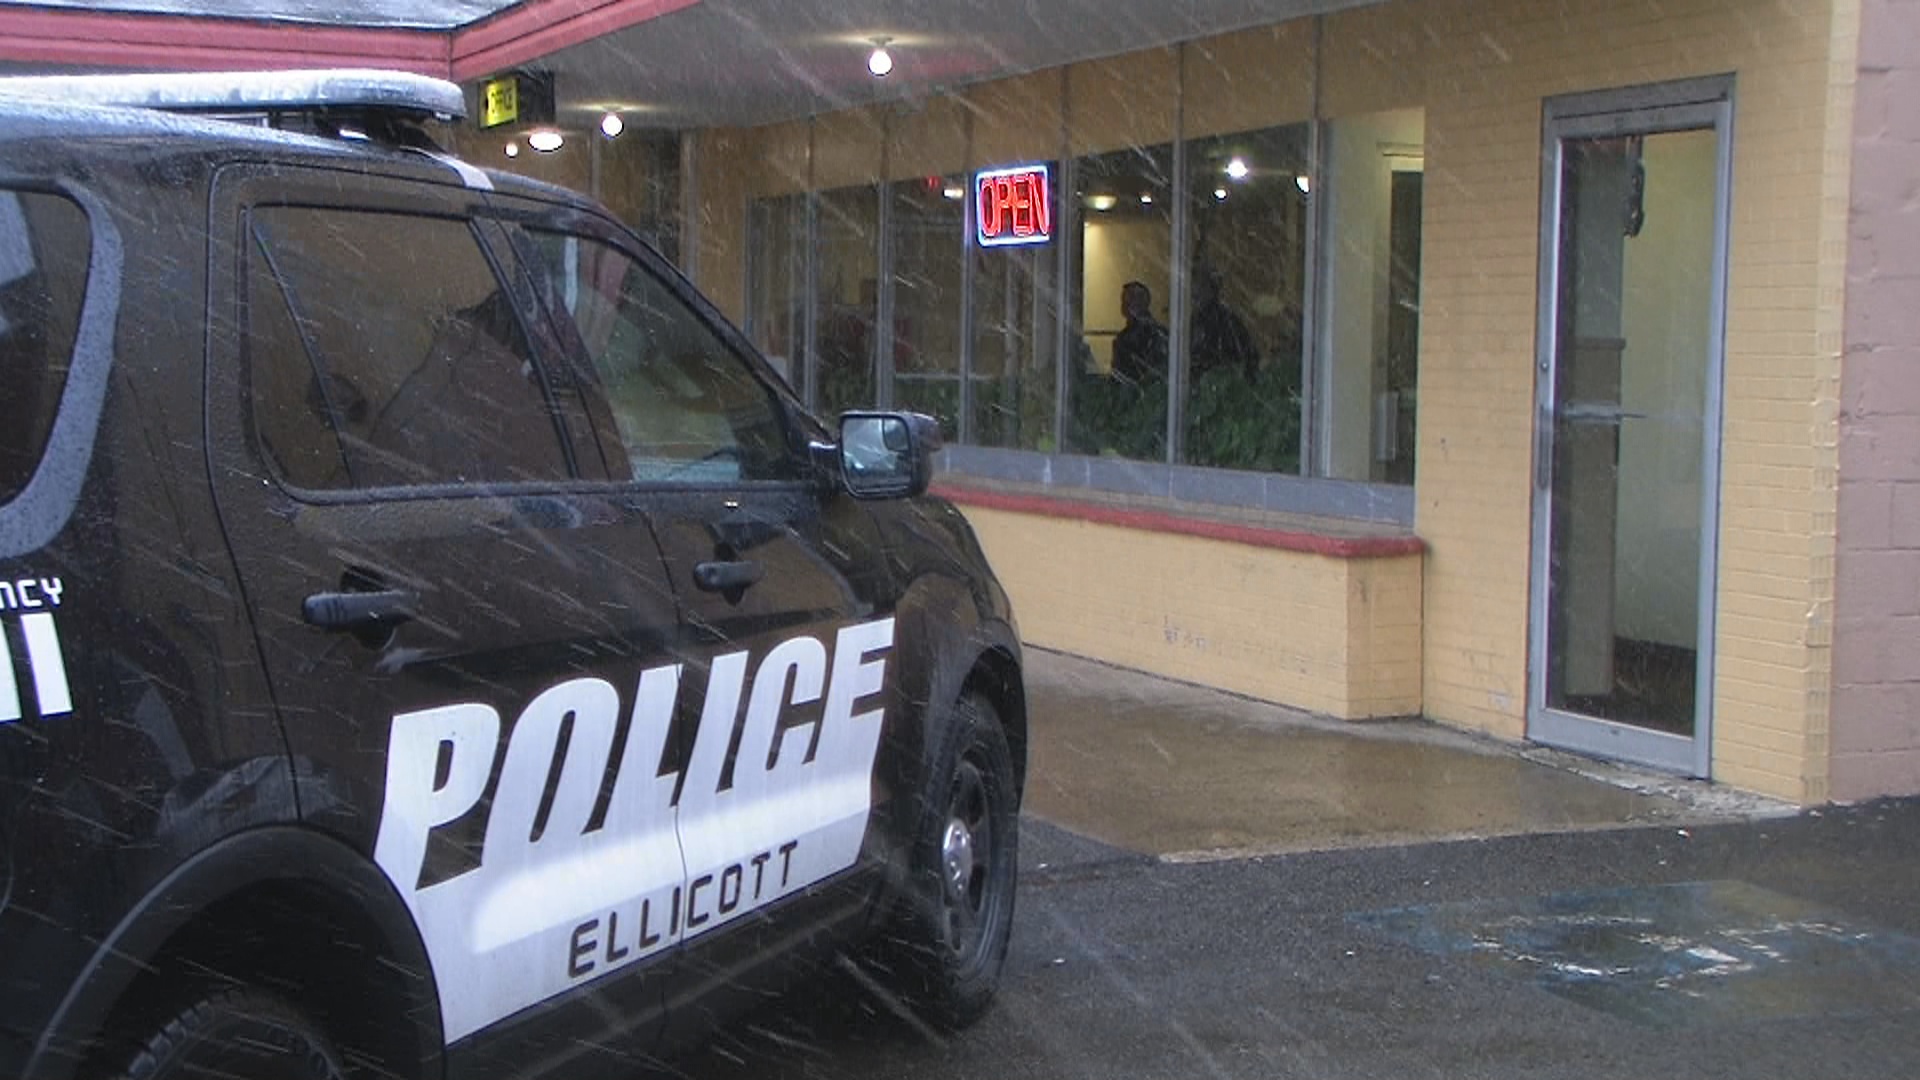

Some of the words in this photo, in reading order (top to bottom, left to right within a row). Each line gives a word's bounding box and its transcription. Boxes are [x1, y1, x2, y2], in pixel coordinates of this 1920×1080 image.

[979, 172, 1050, 238] OPEN
[373, 617, 896, 890] POLICE
[567, 839, 798, 978] ELLICOTT
